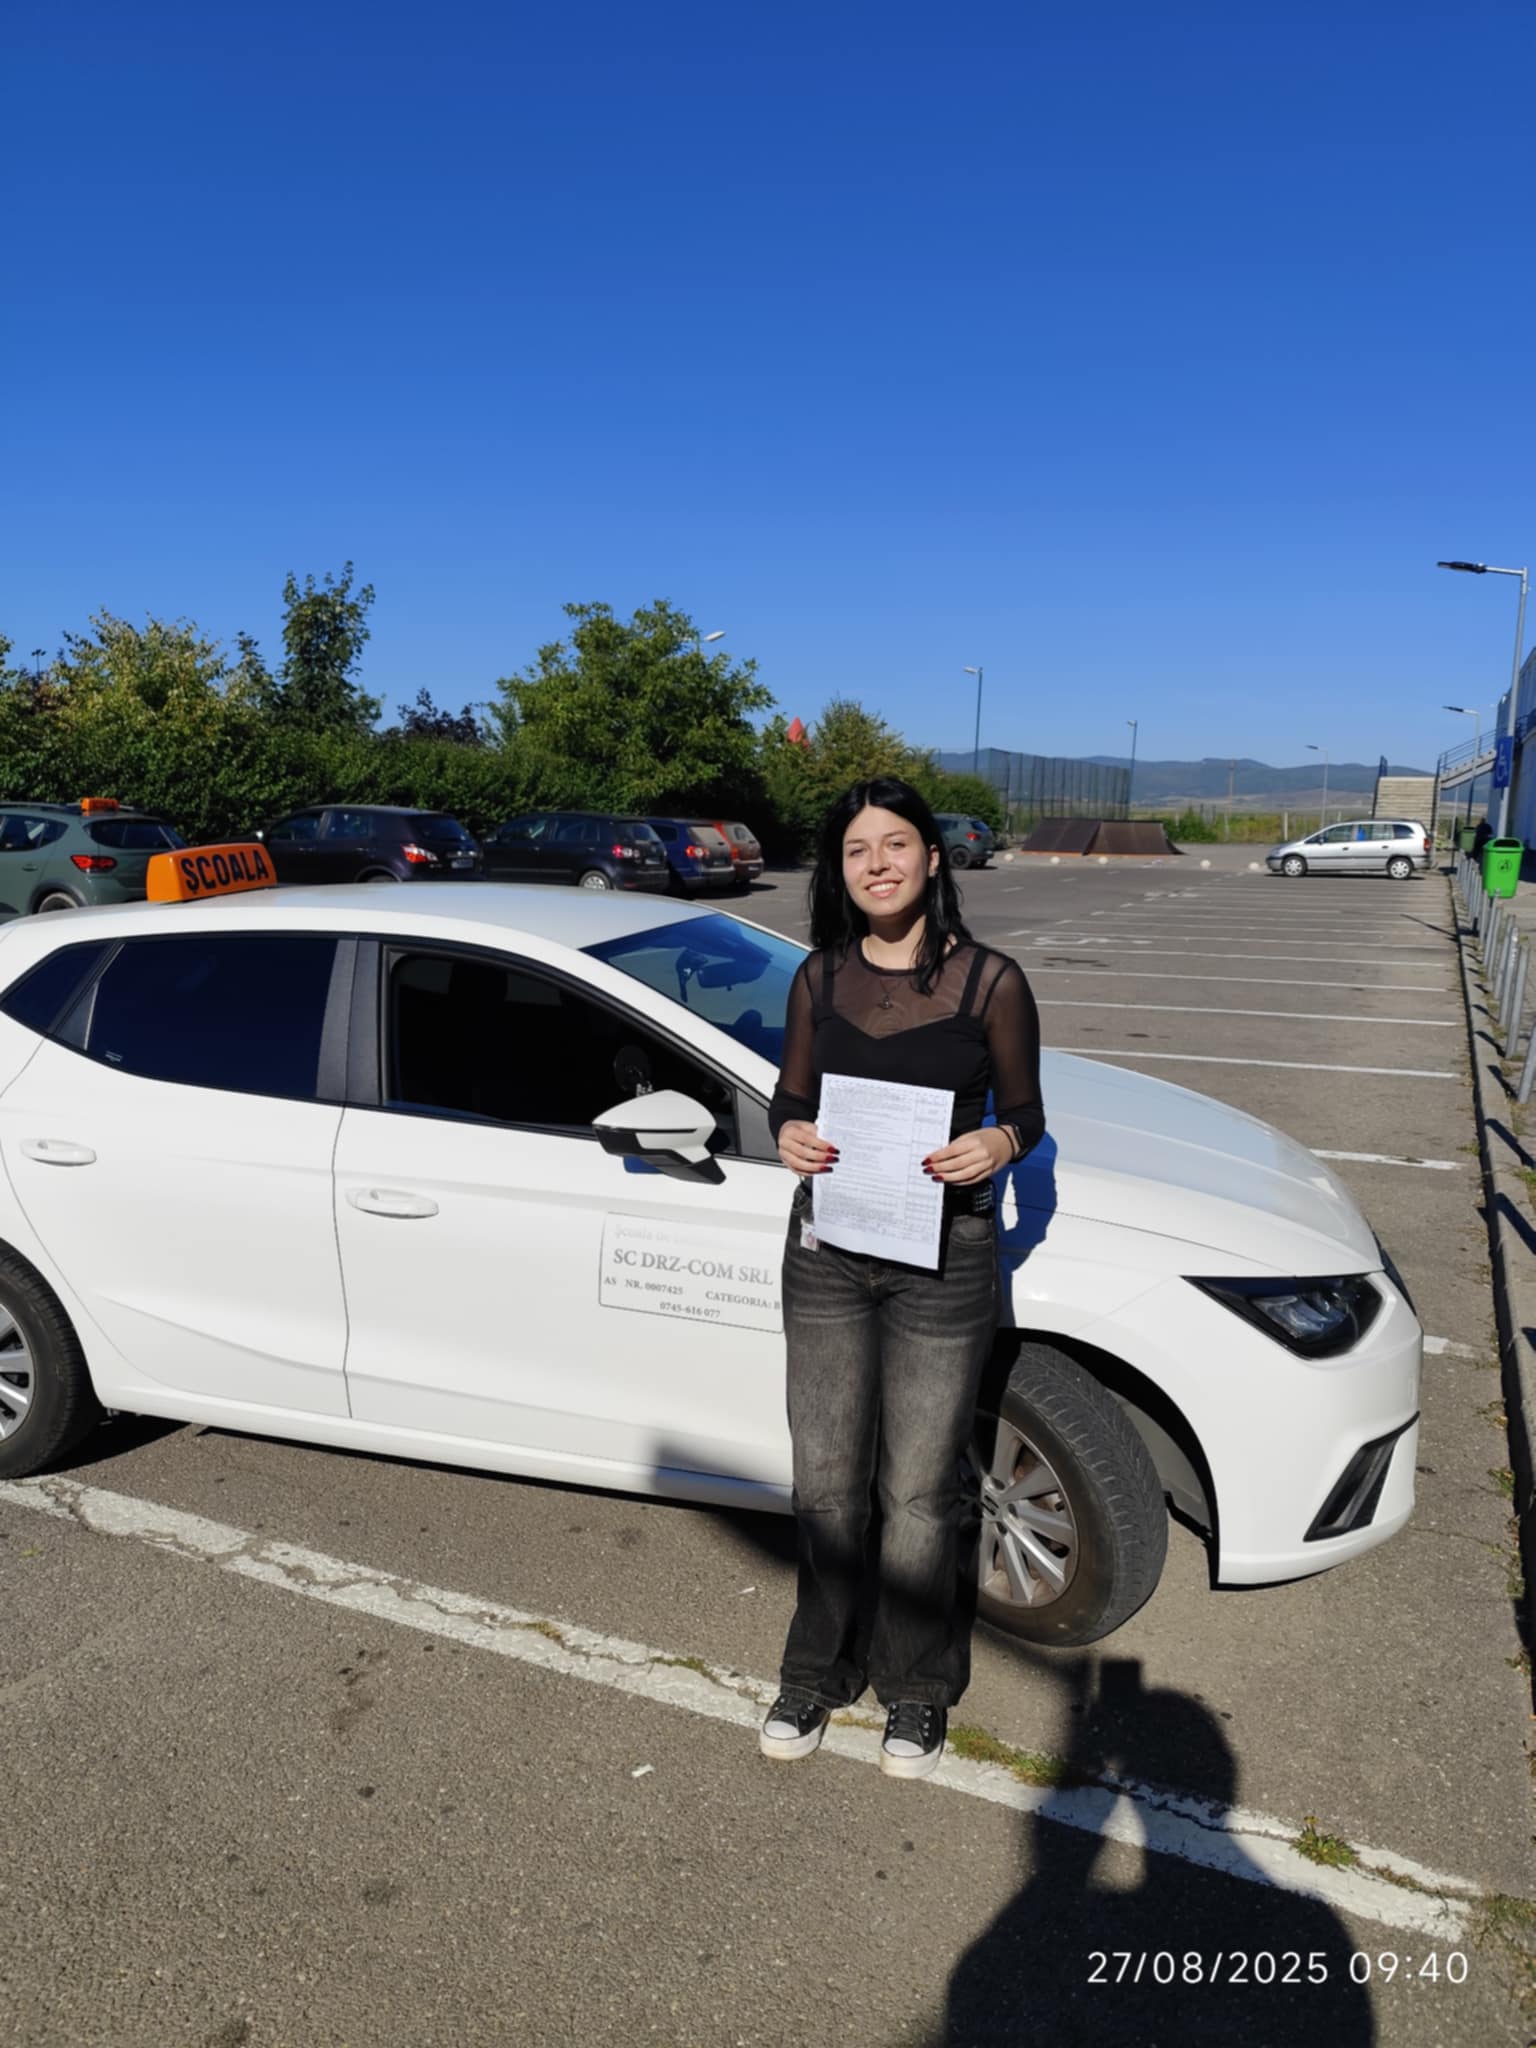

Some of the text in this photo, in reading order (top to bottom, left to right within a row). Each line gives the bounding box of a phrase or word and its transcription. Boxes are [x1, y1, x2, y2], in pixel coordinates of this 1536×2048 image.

[613, 1248, 774, 1286] SC DRZ-COM SRL
[604, 1276, 617, 1286] AS
[705, 1291, 772, 1309] CATEGORIA:
[703, 1307, 721, 1318] 077
